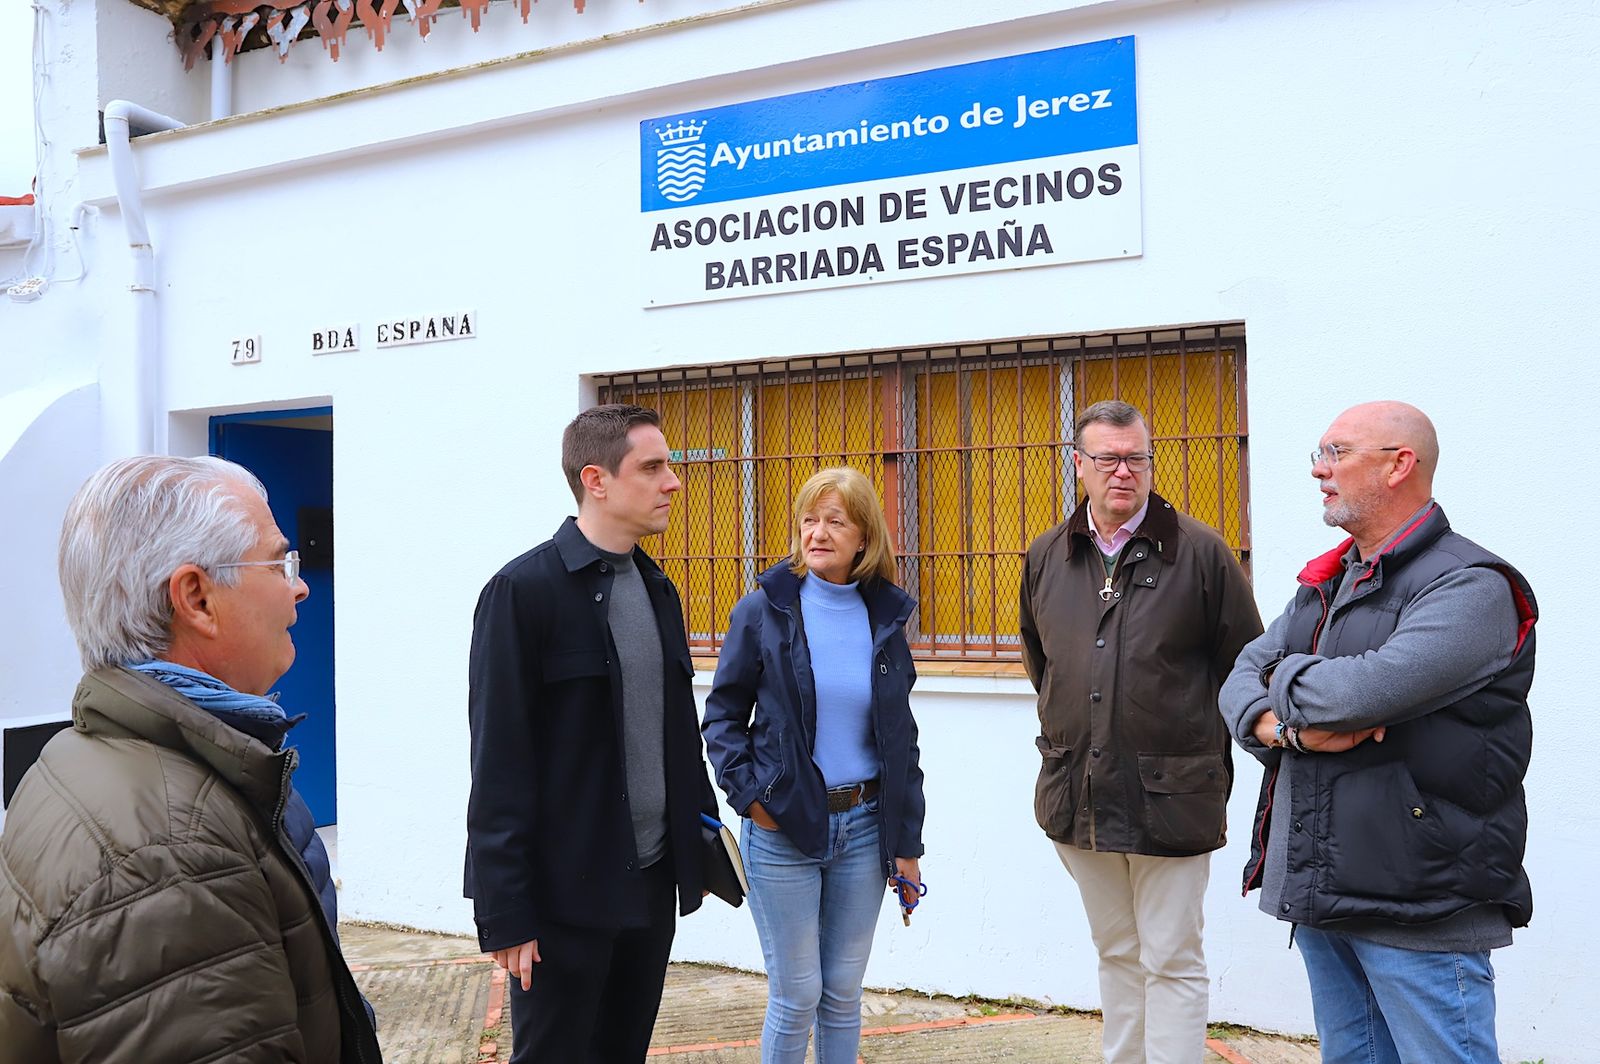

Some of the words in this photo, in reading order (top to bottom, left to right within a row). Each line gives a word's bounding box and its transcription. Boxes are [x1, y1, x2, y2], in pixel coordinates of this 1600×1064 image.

[711, 116, 949, 169] Ayuntamiento
[960, 103, 1004, 128] de
[1014, 88, 1112, 128] Jerez
[651, 196, 864, 251] ASOCIACION
[880, 189, 927, 223] DE
[940, 162, 1122, 214] VECINOS
[705, 243, 884, 290] BARRIADA
[898, 219, 1053, 268] ESPAÑA
[231, 338, 255, 360] 79
[312, 327, 355, 351] BDA
